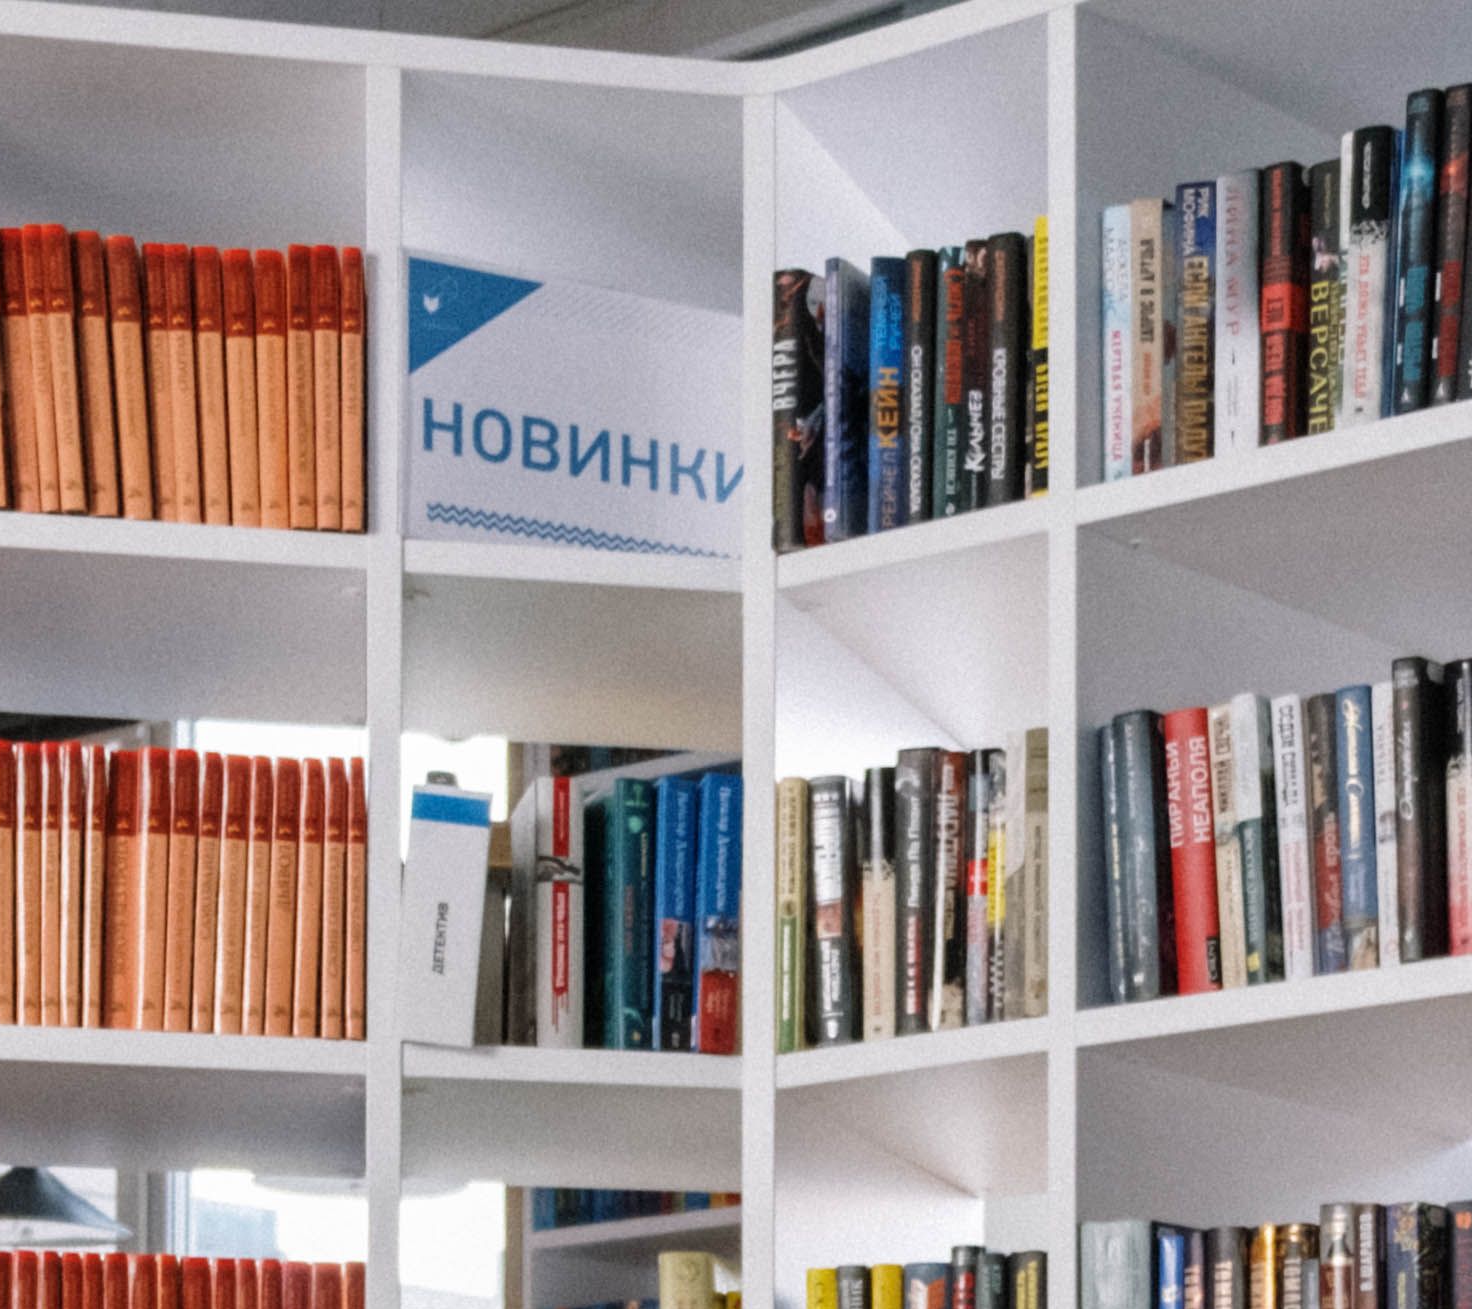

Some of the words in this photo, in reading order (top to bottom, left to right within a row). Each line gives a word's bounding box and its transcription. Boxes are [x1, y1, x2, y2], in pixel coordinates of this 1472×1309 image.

[1182, 255, 1210, 309] ЕСЛИ
[910, 344, 923, 368] ОН
[1181, 314, 1210, 394] АНГЕЛЫ
[1308, 280, 1329, 436] ВЕРСАЧЕ
[875, 366, 899, 450] КЕЙН
[1111, 395, 1124, 463] УЧЕНИЦА
[991, 421, 1007, 480] СЕСТРЫ
[1166, 741, 1186, 848] ПИРАНЬИ
[1189, 735, 1211, 844] НЕАПОЛЯ
[431, 902, 449, 975] ДЕТЕКТИВ
